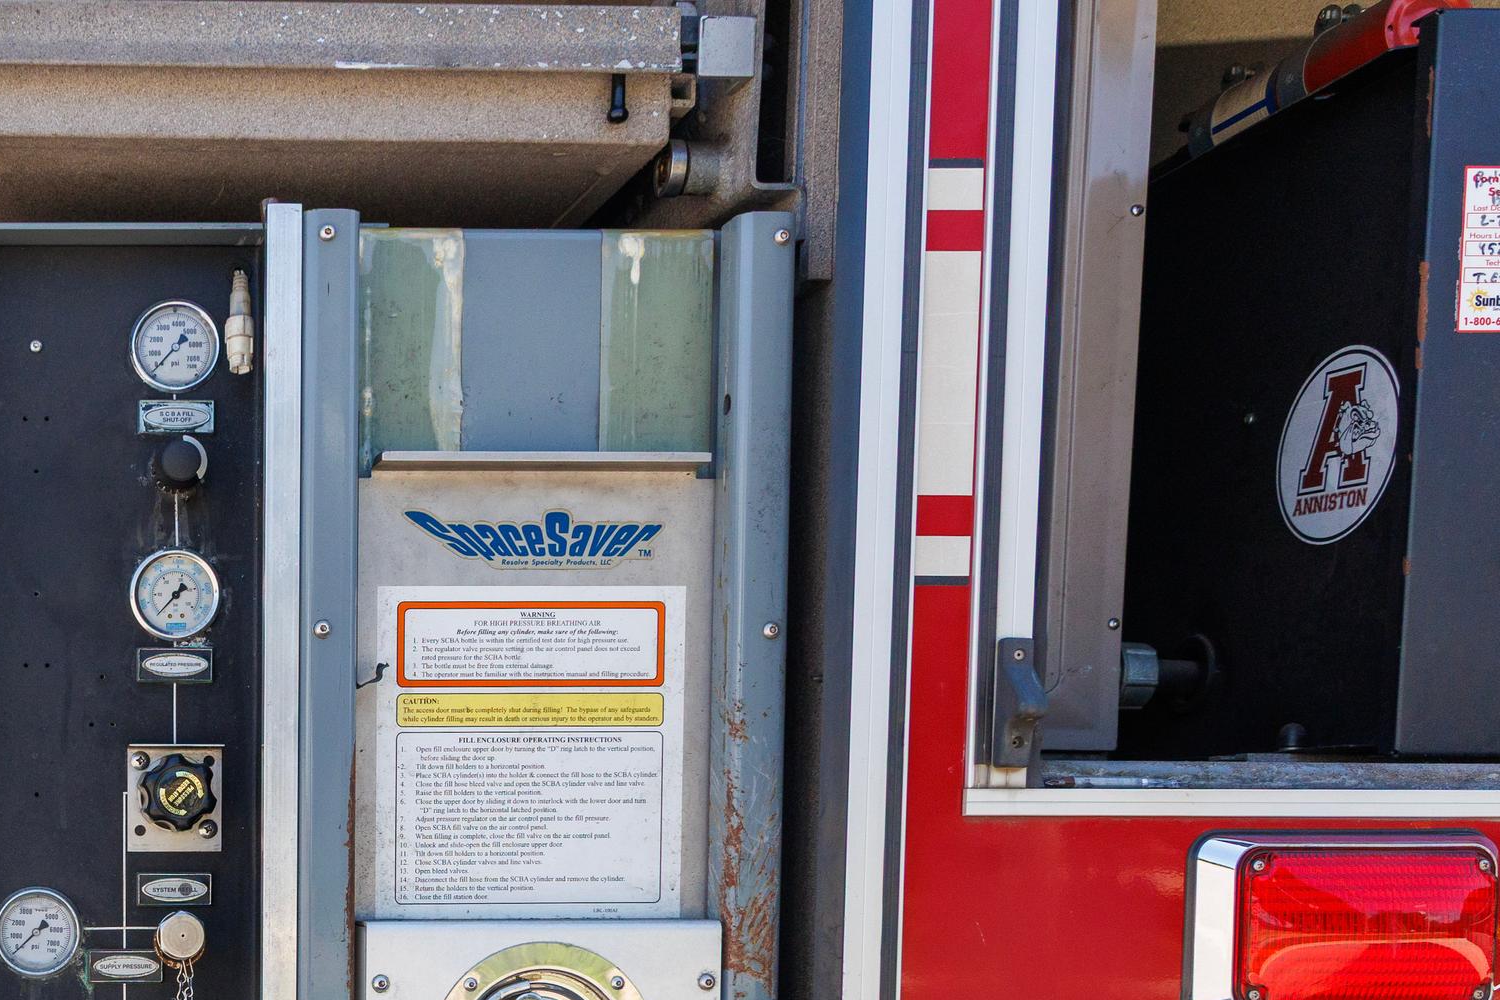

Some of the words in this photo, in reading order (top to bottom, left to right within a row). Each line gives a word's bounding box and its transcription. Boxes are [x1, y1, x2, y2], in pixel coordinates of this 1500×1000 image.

[171, 360, 180, 368] psi
[1293, 487, 1368, 517] ANNISTON
[405, 511, 662, 560] SpaceSaver
[532, 559, 563, 567] Specialty
[566, 559, 597, 567] Products,
[477, 629, 496, 637] filling
[510, 629, 535, 637] cylinder,
[577, 637, 590, 645] high
[414, 868, 430, 876] Open
